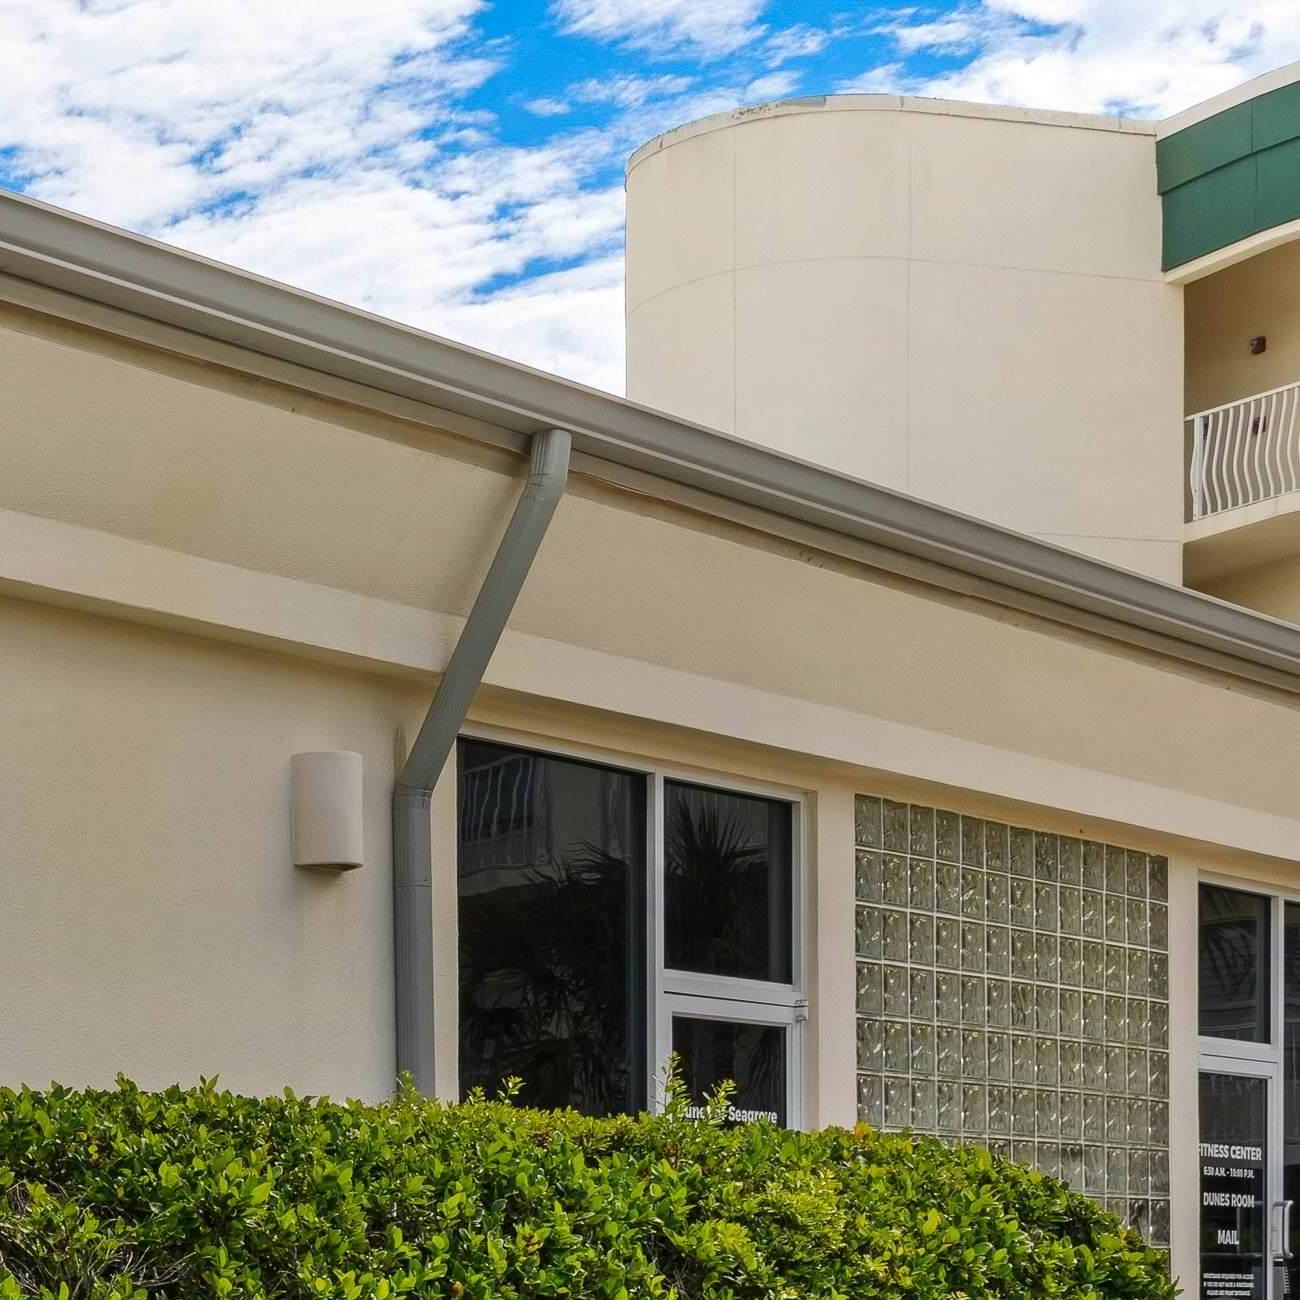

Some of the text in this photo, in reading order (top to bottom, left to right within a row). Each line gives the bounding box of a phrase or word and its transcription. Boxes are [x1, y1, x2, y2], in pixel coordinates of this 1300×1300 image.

[1230, 1145, 1262, 1161] CENTER
[1203, 1192, 1255, 1208] DUNES ROOM
[1217, 1229, 1240, 1245] MAIL
